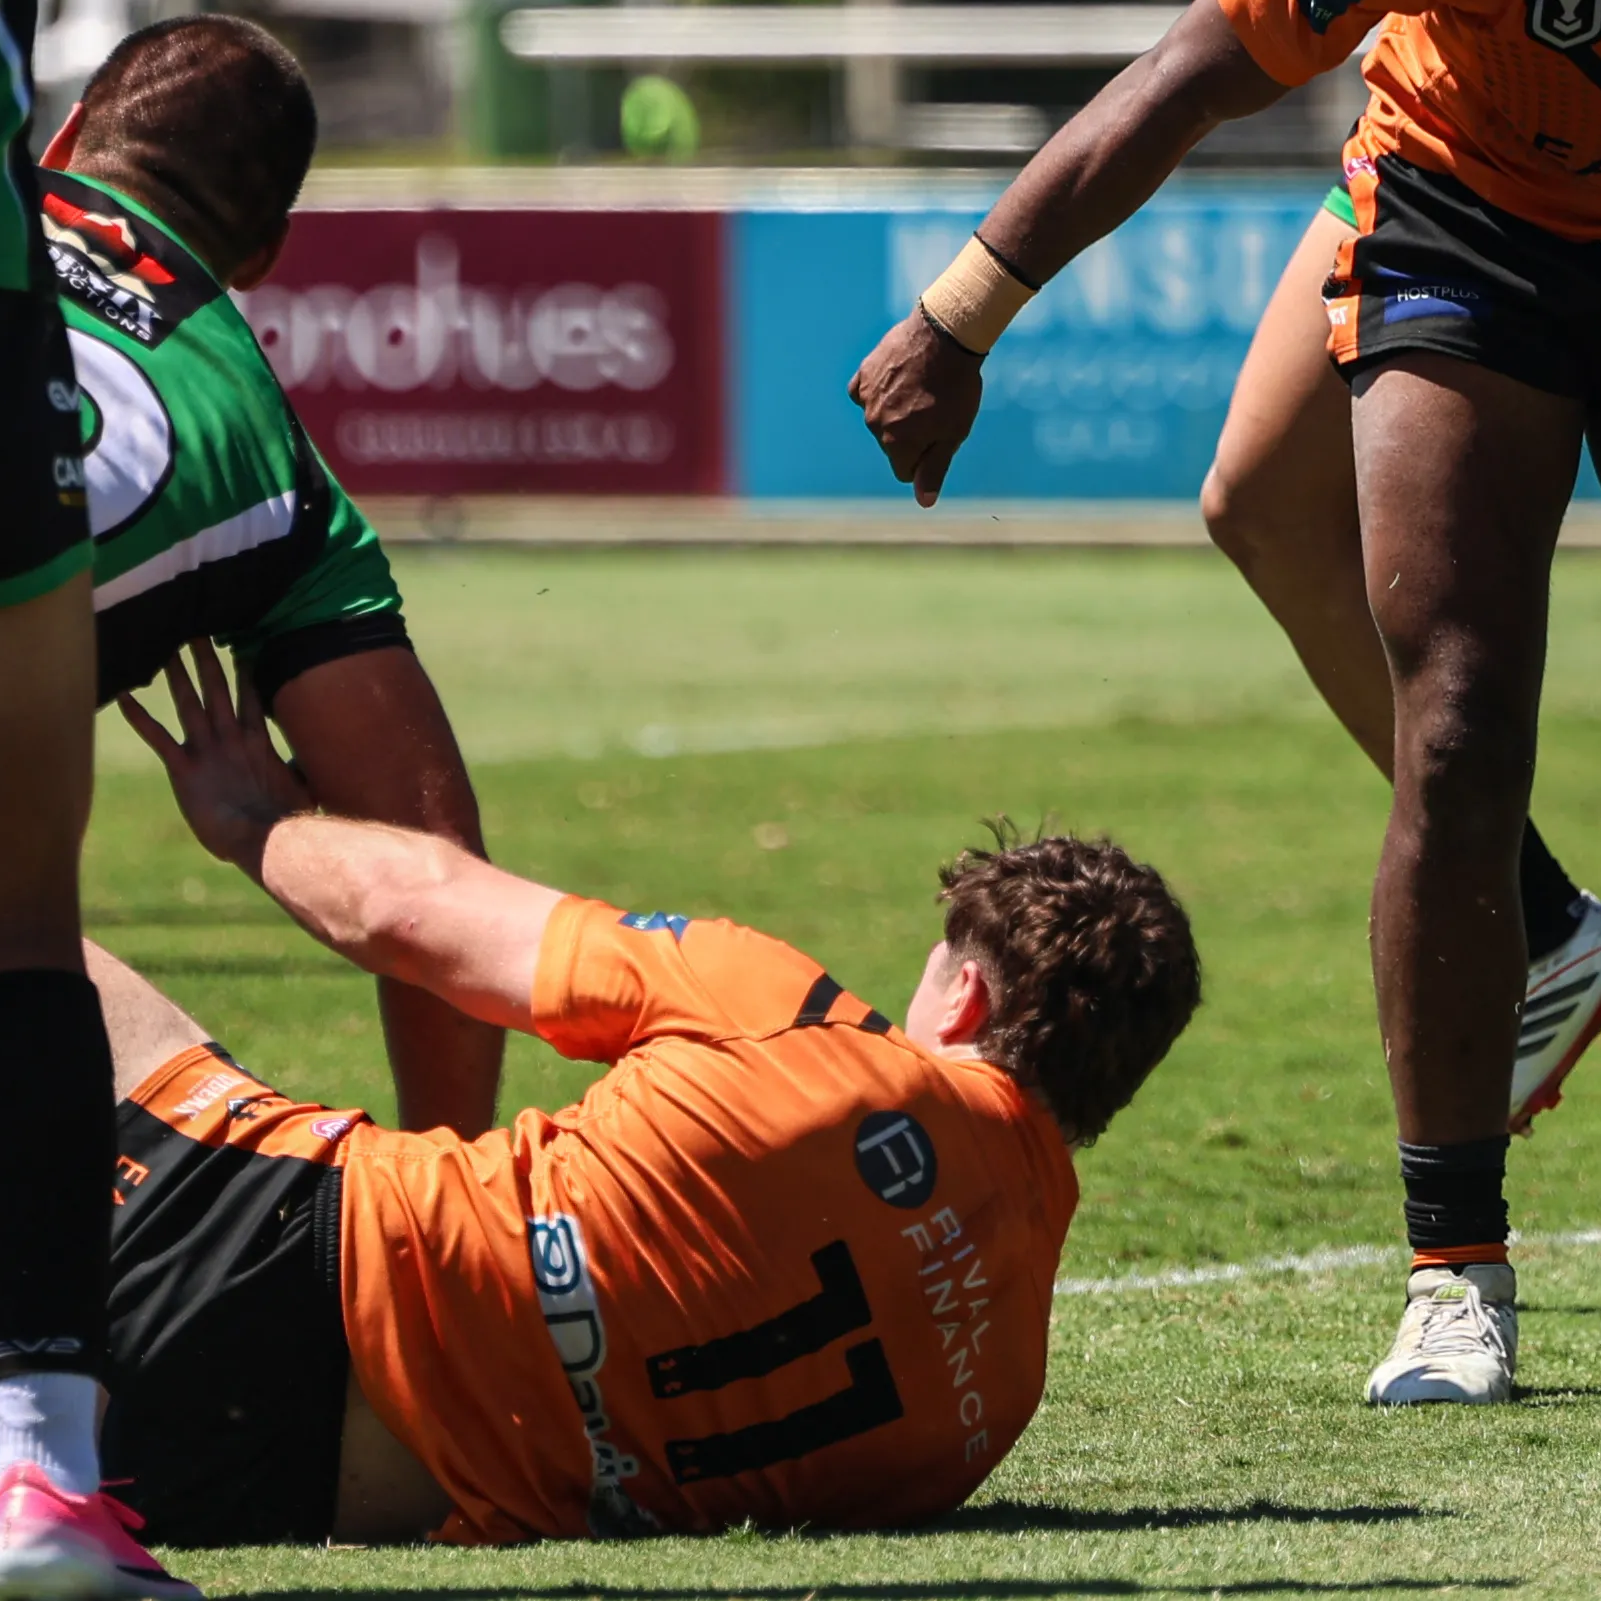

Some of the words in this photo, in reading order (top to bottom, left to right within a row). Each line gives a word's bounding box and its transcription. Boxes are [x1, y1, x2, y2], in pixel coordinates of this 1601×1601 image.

[1396, 285, 1480, 303] HOSTPLUS
[900, 1222, 988, 1463] FINANCE
[931, 1205, 991, 1356] RIVAL
